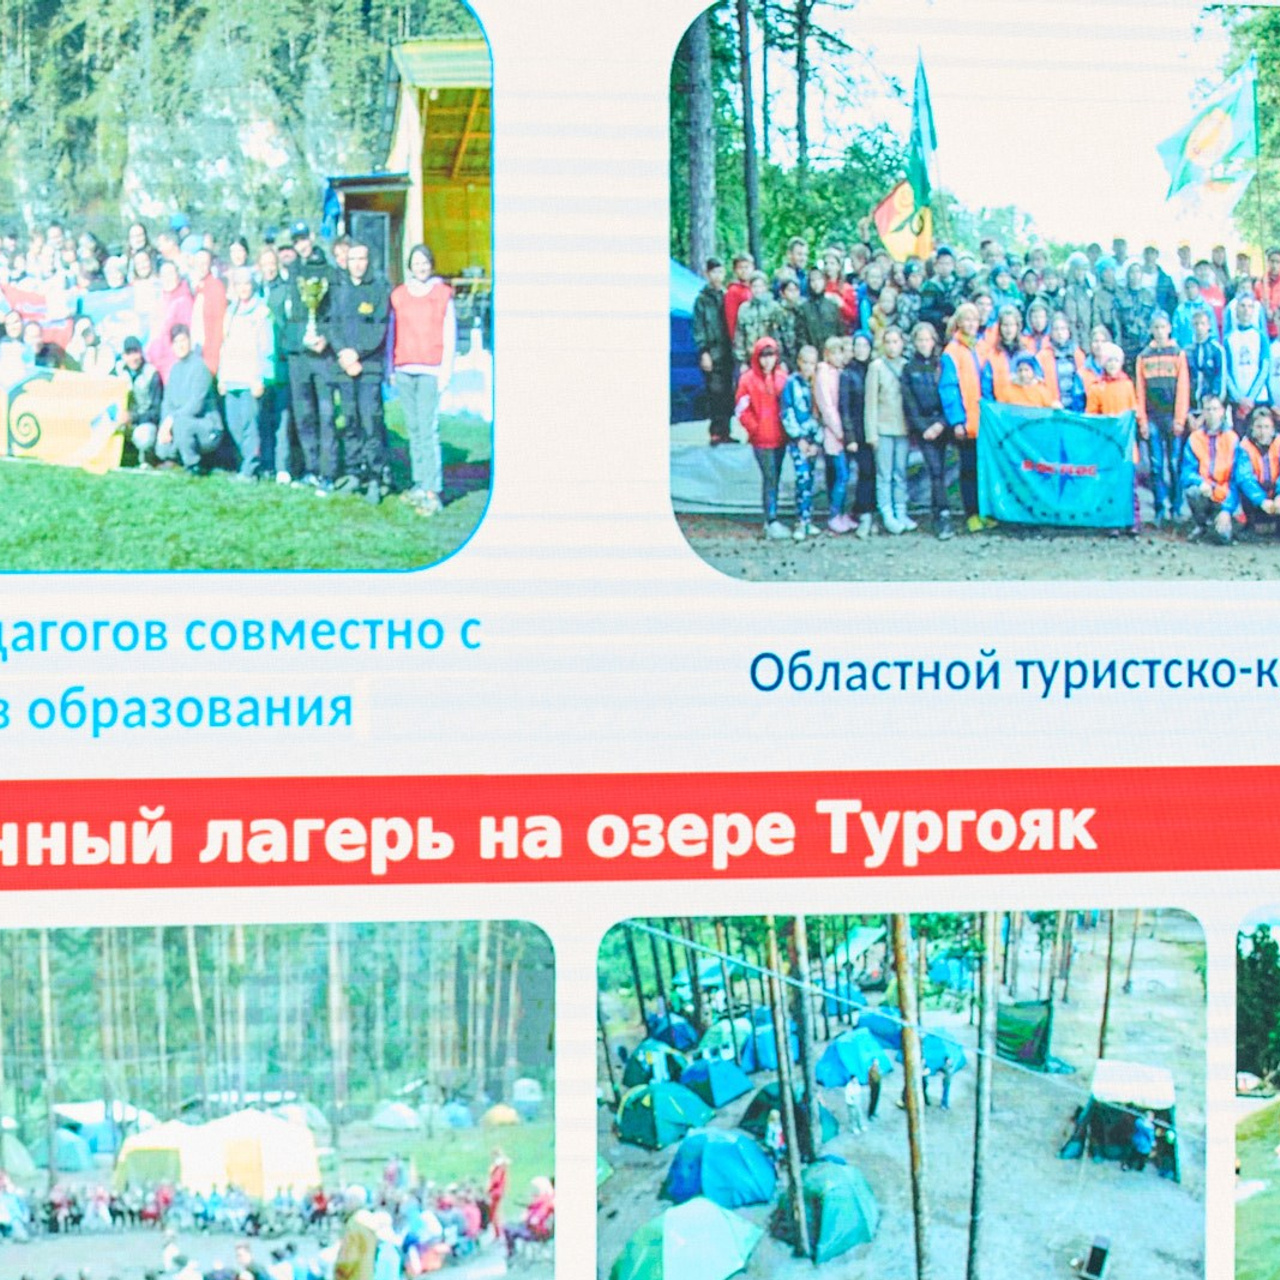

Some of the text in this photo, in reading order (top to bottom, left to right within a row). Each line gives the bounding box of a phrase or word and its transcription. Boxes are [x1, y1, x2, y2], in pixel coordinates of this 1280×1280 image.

[184, 617, 445, 653] совместно
[459, 617, 481, 650] с
[748, 648, 1279, 700] Областной туристско-к
[27, 685, 353, 739] образования
[199, 814, 455, 876] лагерь
[479, 813, 563, 862] на
[586, 810, 796, 871] озере
[815, 799, 1099, 868] Тургояк
